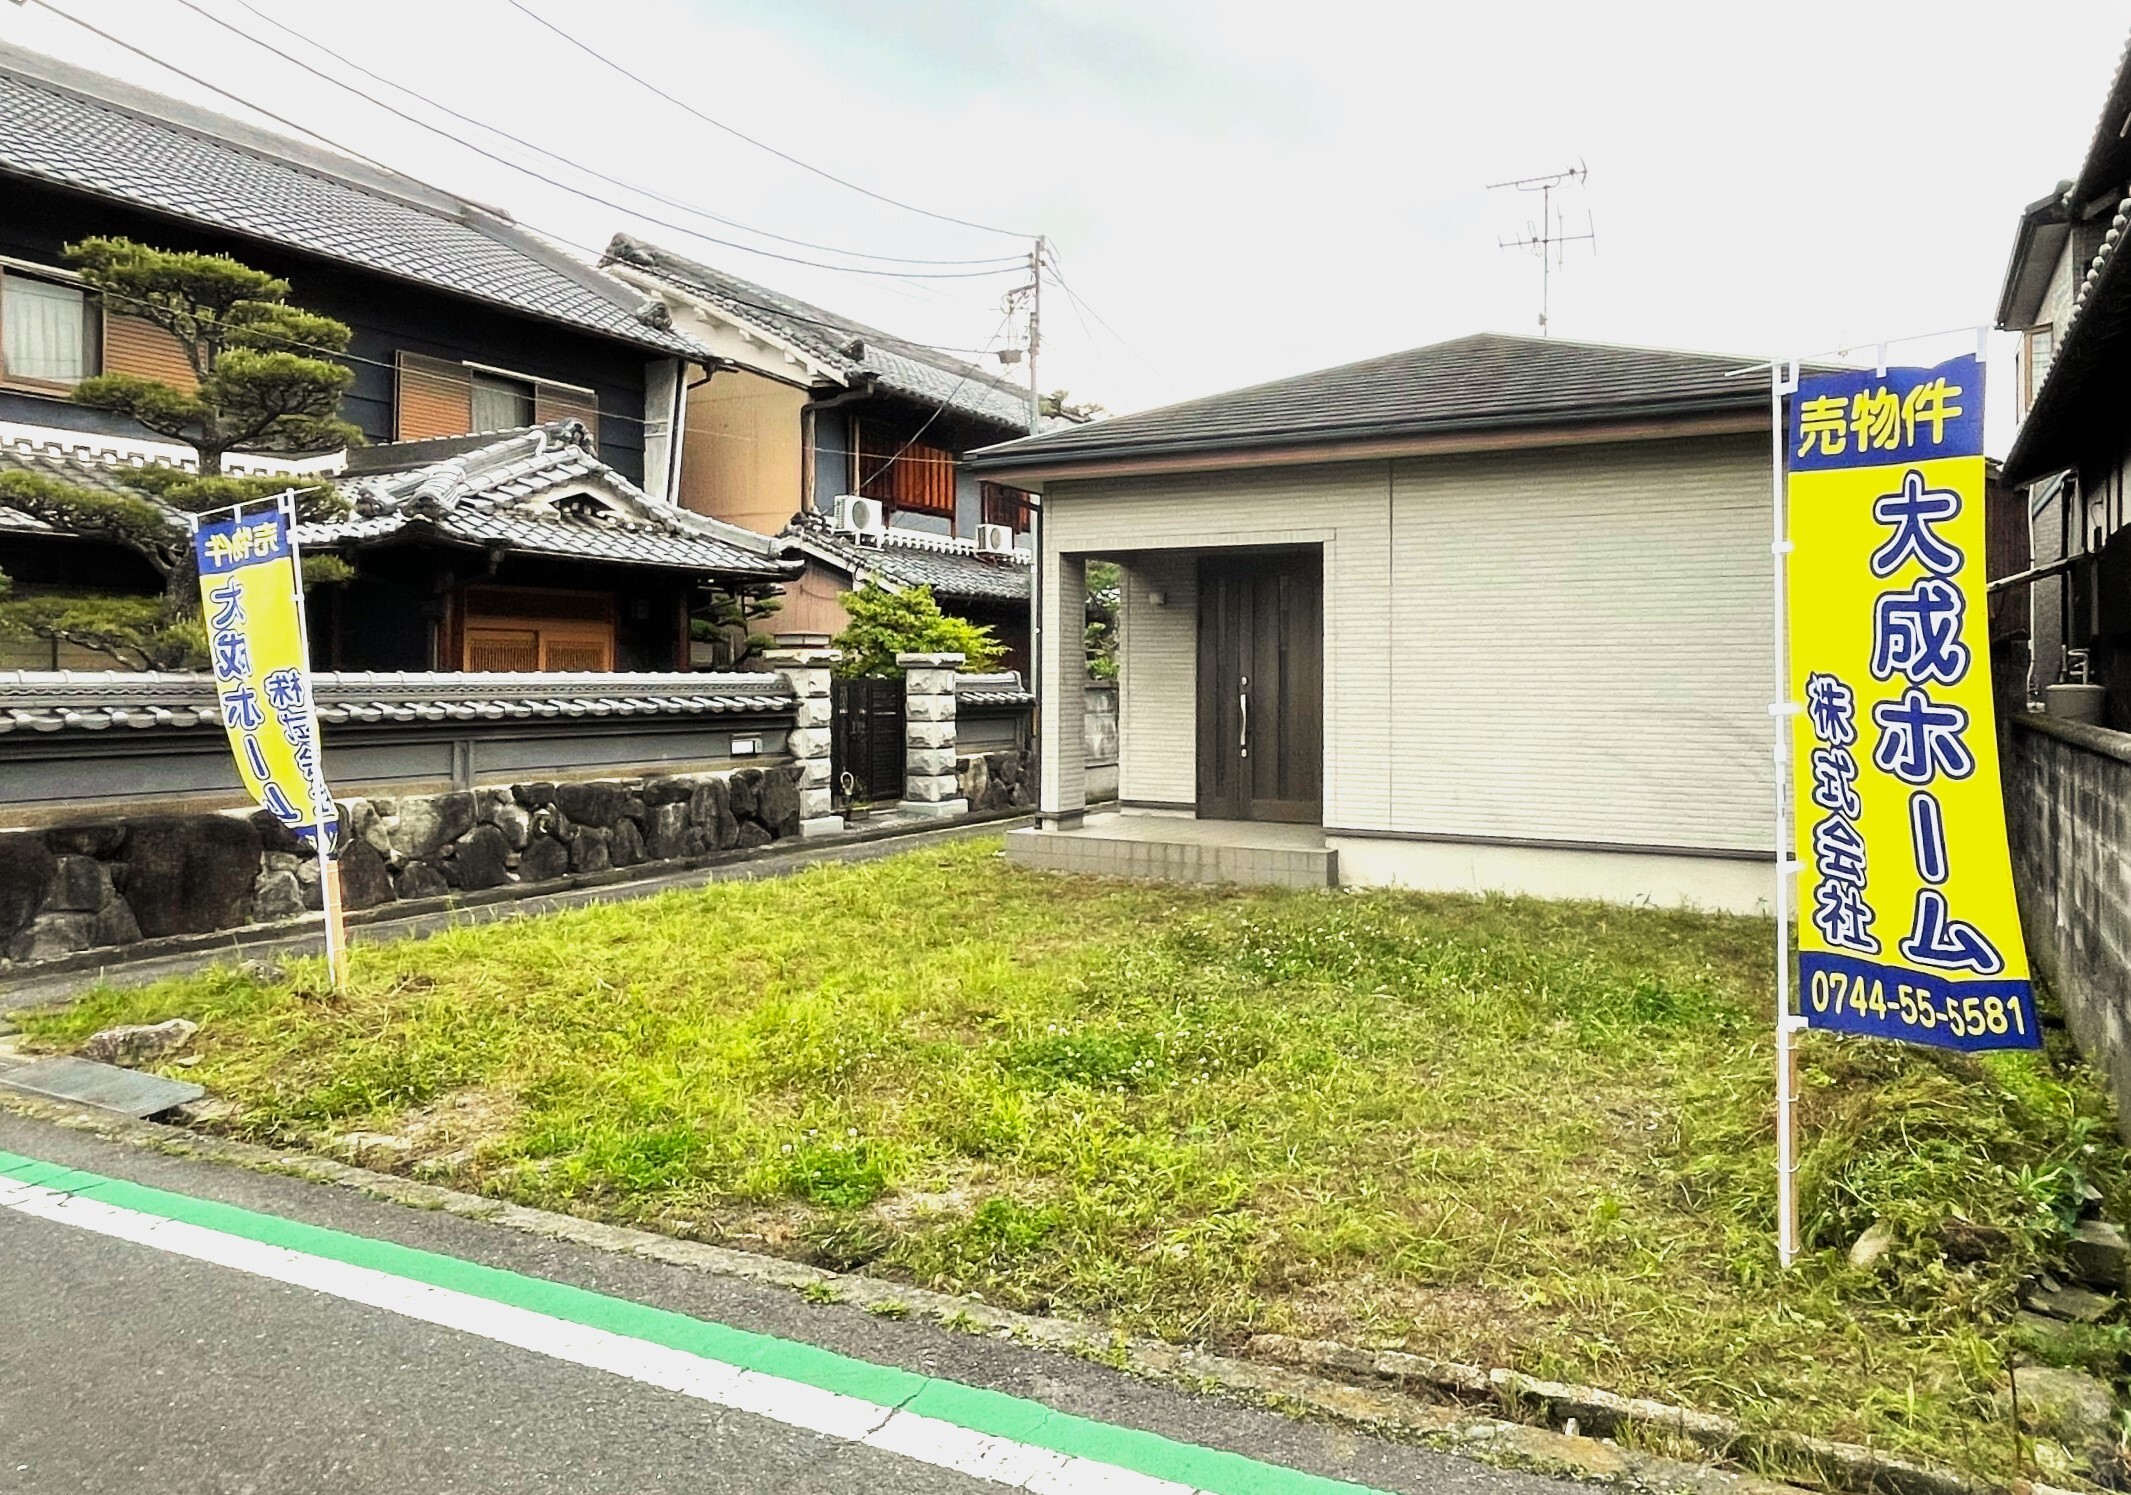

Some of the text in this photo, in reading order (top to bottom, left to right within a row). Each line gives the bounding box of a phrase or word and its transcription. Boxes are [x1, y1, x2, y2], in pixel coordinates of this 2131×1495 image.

[1798, 377, 1963, 458] 売物件
[1870, 469, 2005, 975] 大成ホーム
[1806, 672, 1881, 955] 株式会社
[1811, 970, 2025, 1036] 0744-55-5581
